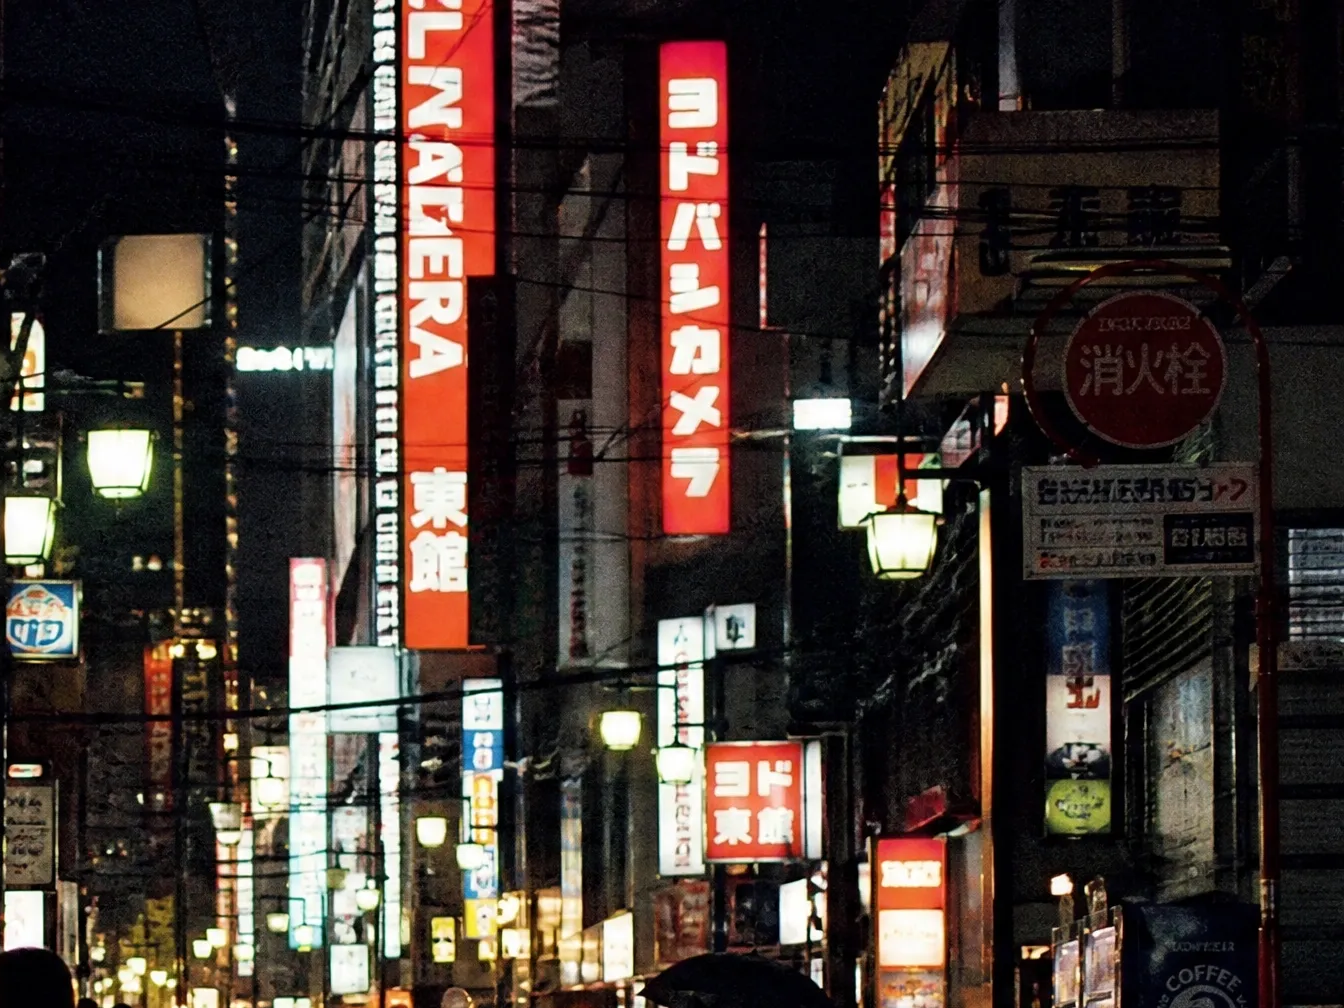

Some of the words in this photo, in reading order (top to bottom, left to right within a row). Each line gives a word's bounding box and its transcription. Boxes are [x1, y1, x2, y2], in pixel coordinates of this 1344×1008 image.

[668, 77, 723, 498] ヨドバシカメラ
[1079, 341, 1211, 396] 消火栓
[409, 466, 468, 592] 東館
[714, 759, 793, 797] ヨド
[1165, 964, 1243, 993] COFFEE
